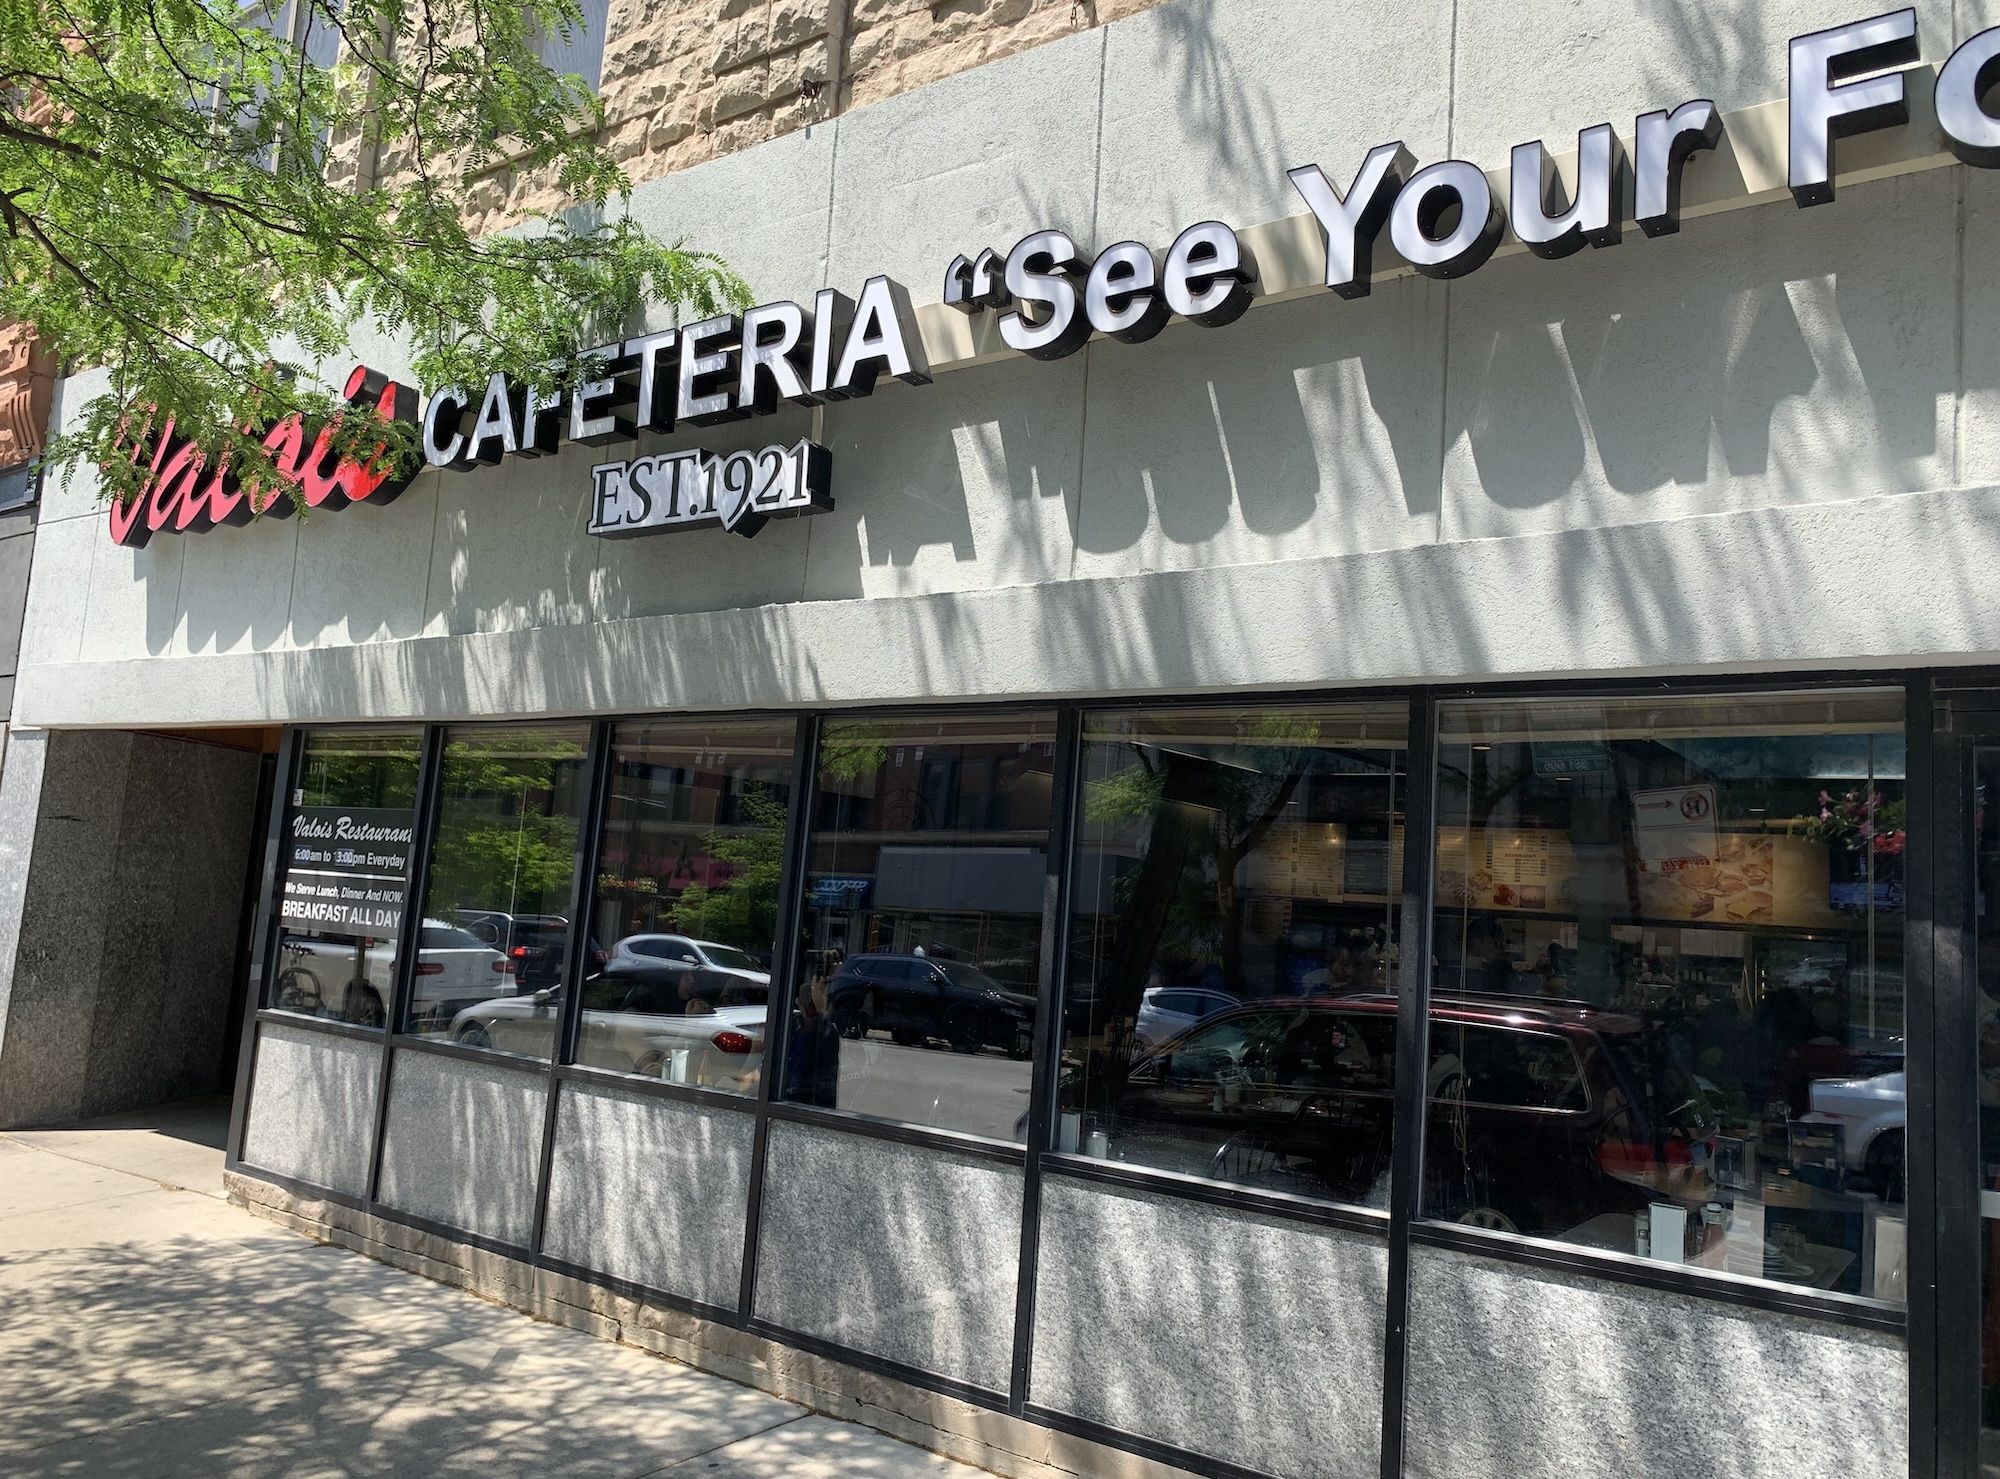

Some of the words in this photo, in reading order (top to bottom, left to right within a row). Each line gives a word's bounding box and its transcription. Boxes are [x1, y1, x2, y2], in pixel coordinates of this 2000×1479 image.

[422, 275, 914, 467] CAFETERIA
[1287, 99, 1716, 287] Your
[292, 814, 333, 838] Valois
[322, 850, 332, 862] to
[367, 852, 405, 870] Everyday
[285, 882, 296, 894] We
[296, 883, 316, 895] Serve
[316, 885, 340, 899] Lunch,
[341, 887, 366, 900] Dinner
[365, 889, 382, 901] And
[281, 899, 349, 922] BREAKFAST
[349, 907, 373, 925] ALL
[375, 909, 402, 929] DAY
